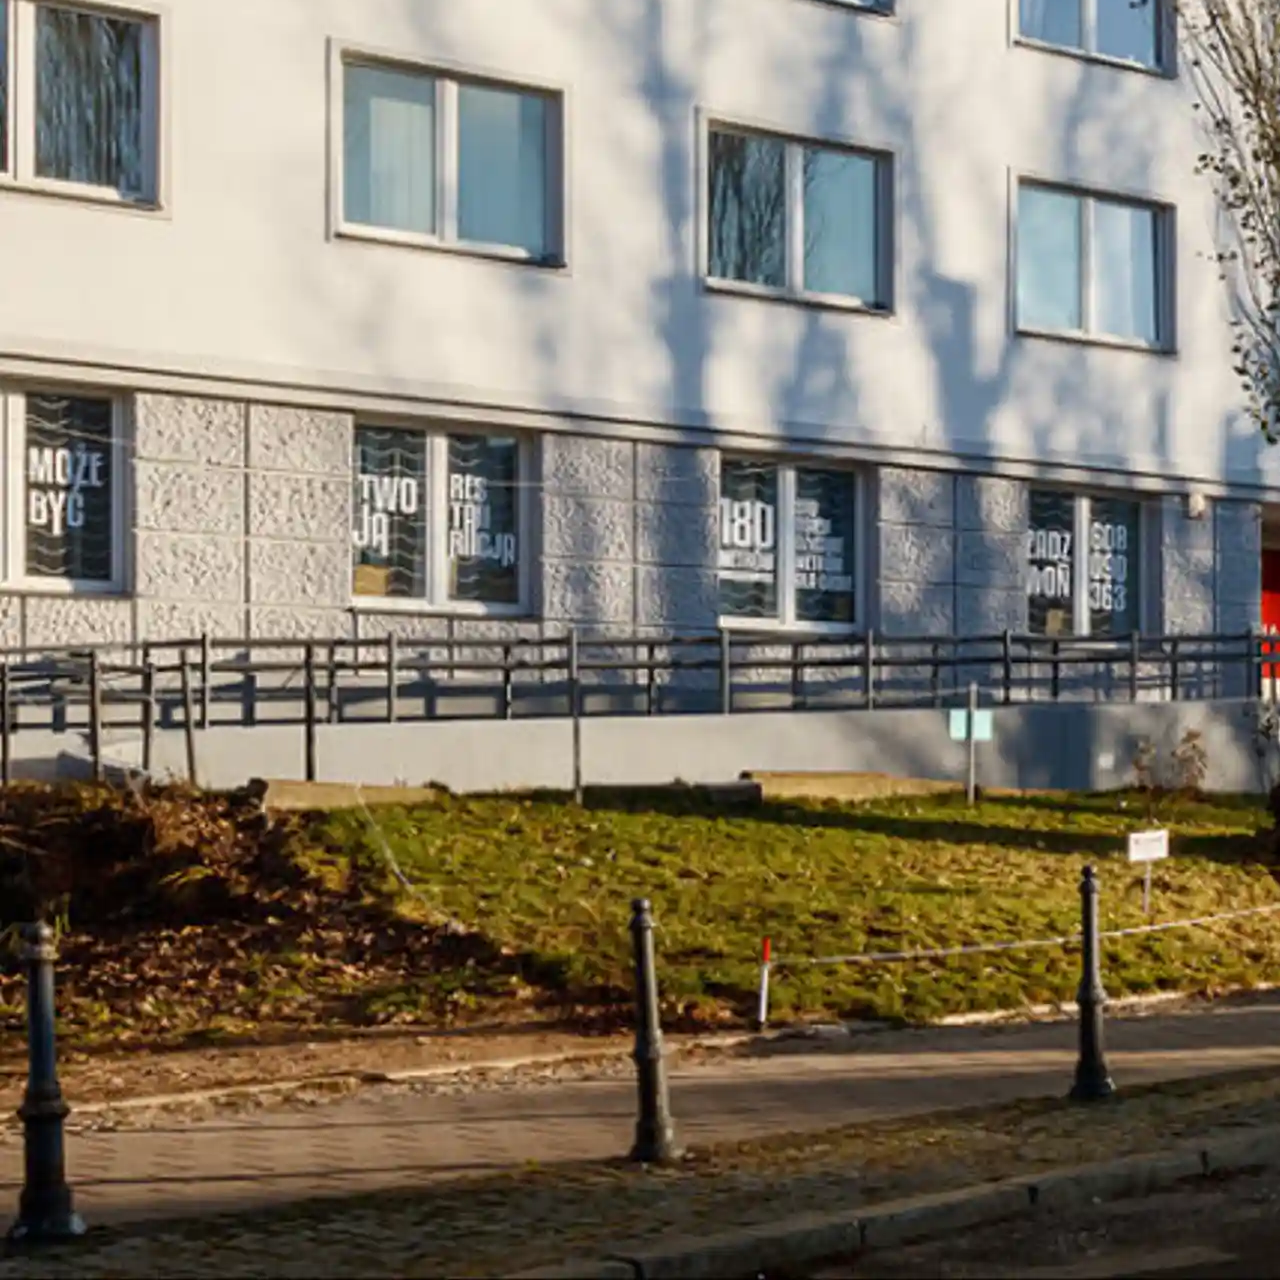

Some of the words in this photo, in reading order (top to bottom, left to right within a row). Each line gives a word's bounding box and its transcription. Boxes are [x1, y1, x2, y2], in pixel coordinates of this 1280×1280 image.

[28, 441, 105, 487] MOŻE
[358, 473, 419, 514] TWO
[450, 473, 488, 502] RES
[718, 497, 776, 548] 180
